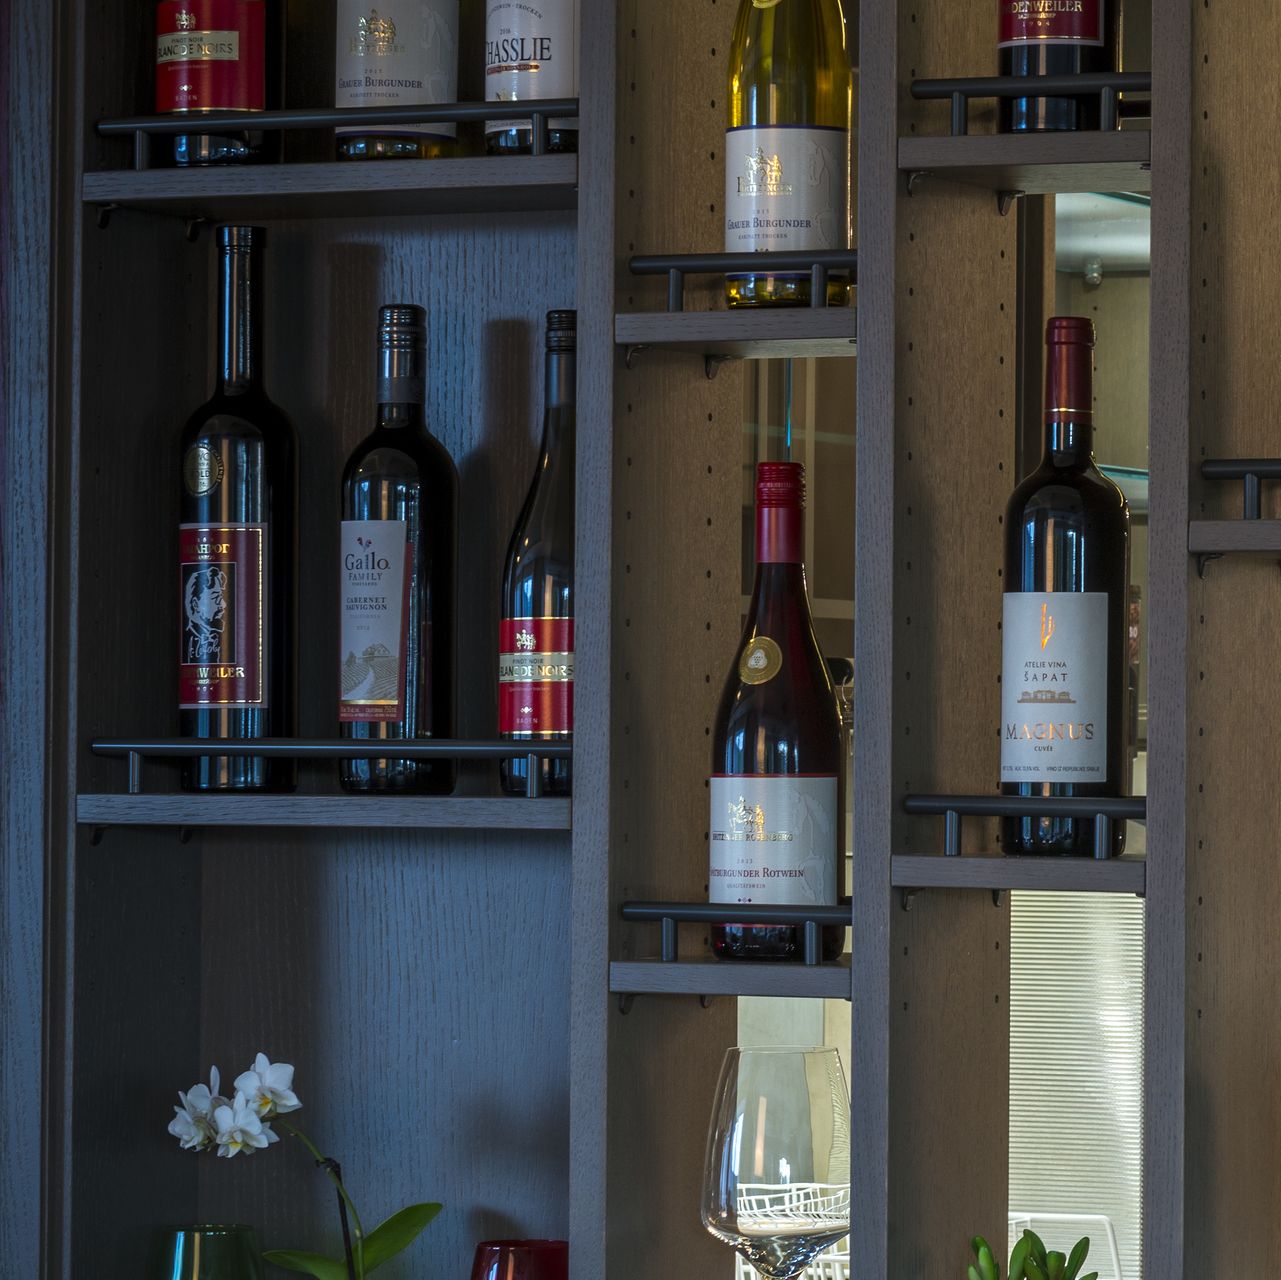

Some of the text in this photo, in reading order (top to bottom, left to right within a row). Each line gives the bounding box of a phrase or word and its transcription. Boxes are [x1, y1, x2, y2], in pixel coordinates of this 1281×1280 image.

[180, 43, 194, 55] DE
[196, 42, 235, 56] NOIRS
[364, 76, 424, 89] BURGUNDER
[753, 217, 812, 228] BURGUNDER
[345, 552, 388, 571] Gallo
[349, 572, 383, 581] FAMILY
[346, 596, 386, 604] CABERNET
[346, 603, 388, 611] SAUVIGNON
[1048, 660, 1067, 669] VINA
[520, 665, 574, 677] DE NOIRS
[1023, 671, 1068, 682] ŠAPAT
[1005, 722, 1094, 741] MAGNUS
[762, 867, 804, 878] ROTWEIN
